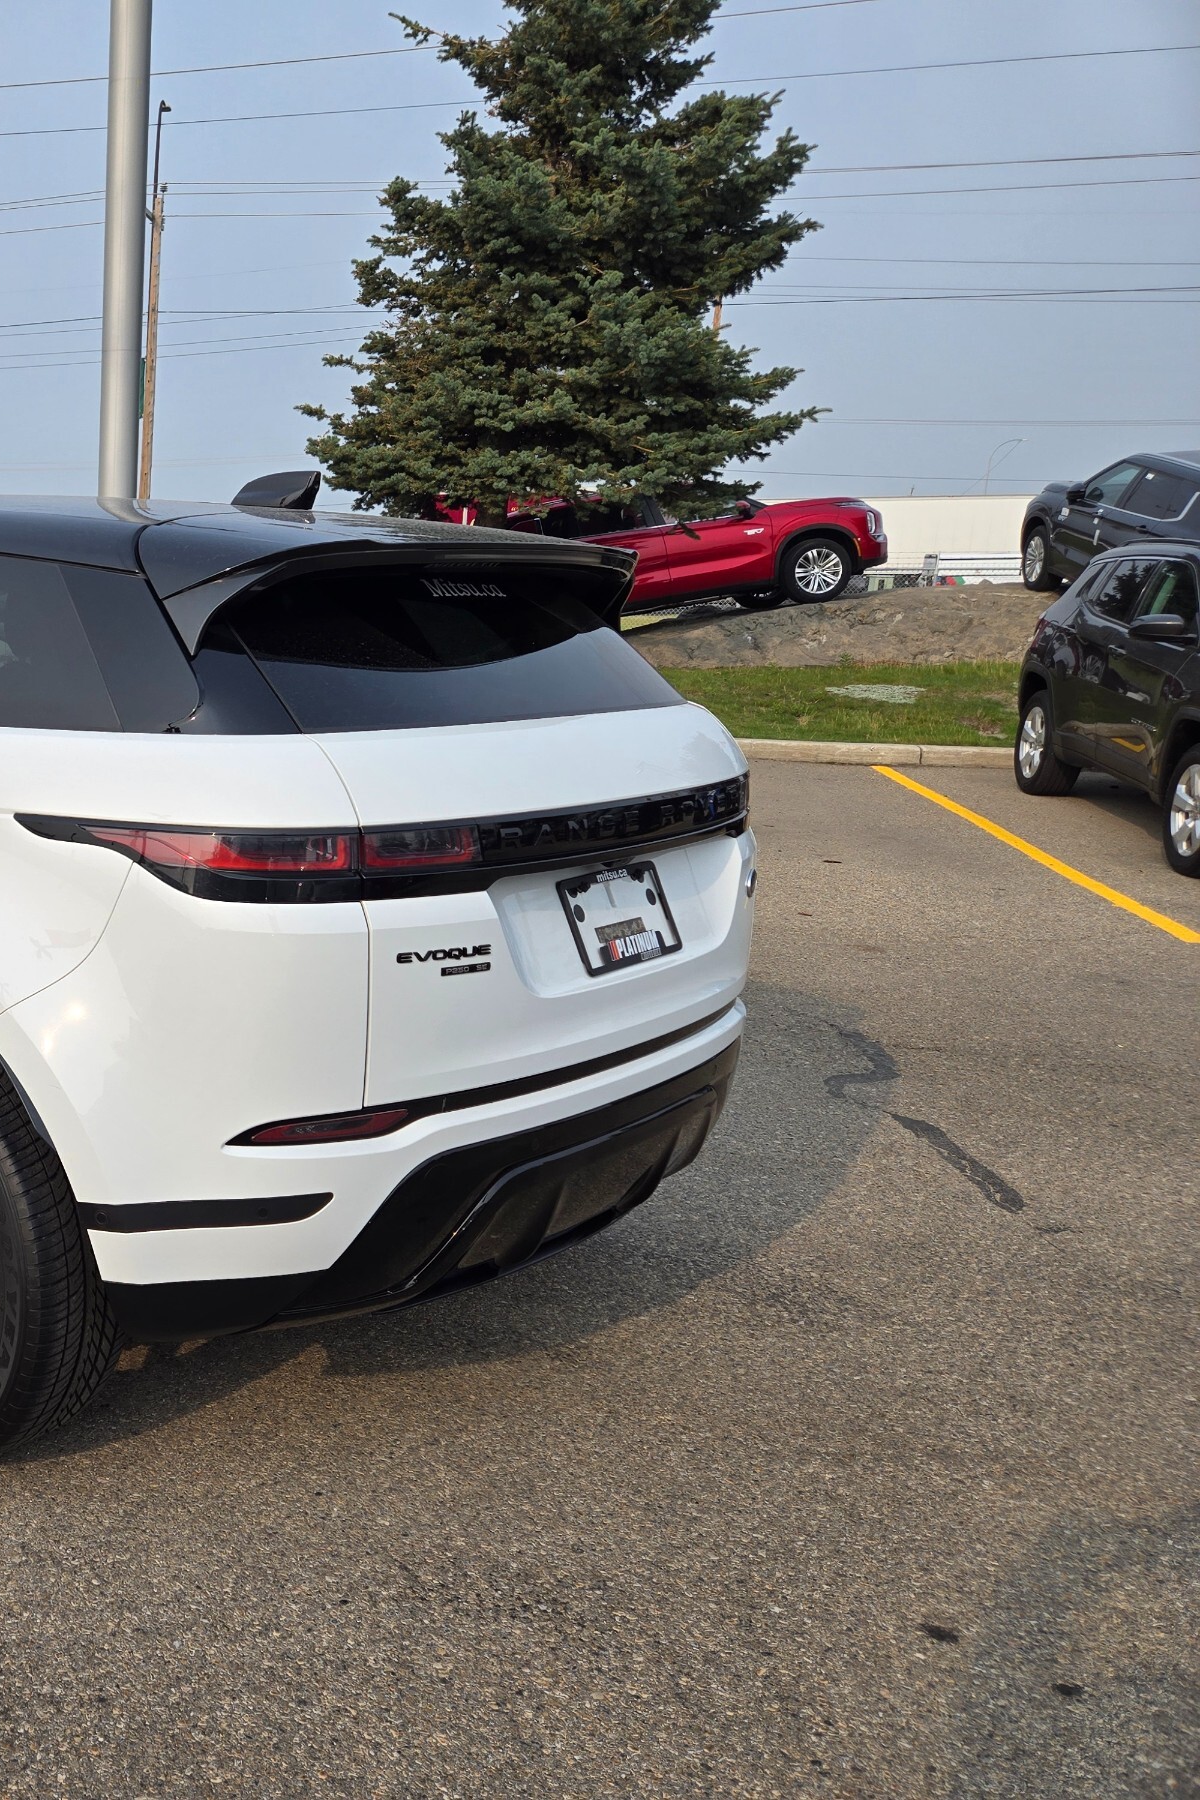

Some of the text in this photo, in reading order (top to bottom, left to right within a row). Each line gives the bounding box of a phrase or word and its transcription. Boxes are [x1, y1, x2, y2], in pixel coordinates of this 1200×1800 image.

[421, 578, 507, 597] Mitsu.ca
[499, 809, 642, 849] RANGE
[596, 868, 628, 882] mitsu.ca
[396, 944, 491, 964] EVOQUE
[616, 930, 660, 959] PLATINUM
